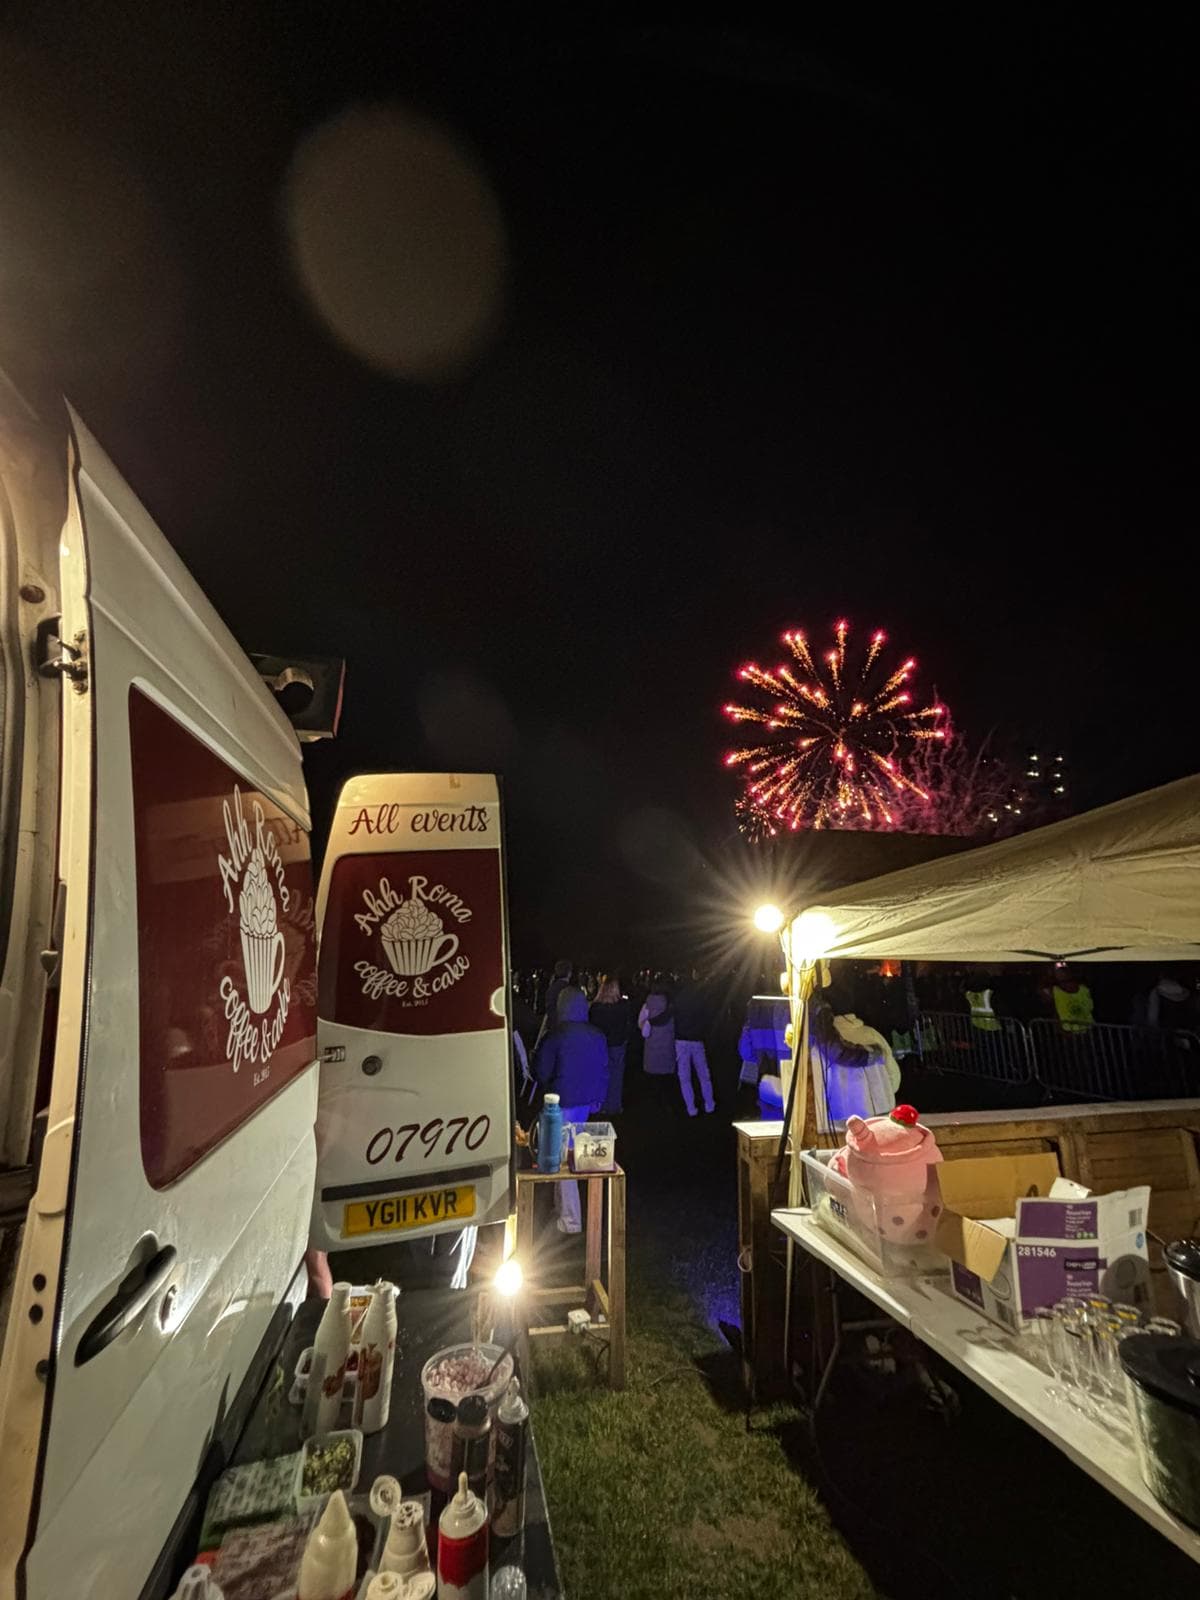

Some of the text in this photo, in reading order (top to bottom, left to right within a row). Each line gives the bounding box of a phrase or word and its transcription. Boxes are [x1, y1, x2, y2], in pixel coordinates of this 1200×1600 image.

[348, 803, 491, 835] All events
[217, 784, 290, 914] Ahh Roma
[354, 876, 403, 936] Ahh
[408, 875, 473, 924] Roma
[354, 960, 408, 1000] coffee
[412, 975, 432, 998] &
[432, 954, 470, 993] cake
[220, 975, 259, 1073] coffee
[260, 1018, 273, 1064] &
[271, 977, 291, 1050] cake
[365, 1114, 491, 1165] 07970
[365, 1190, 458, 1228] YG11 KVR
[1018, 1246, 1057, 1258] 281546
